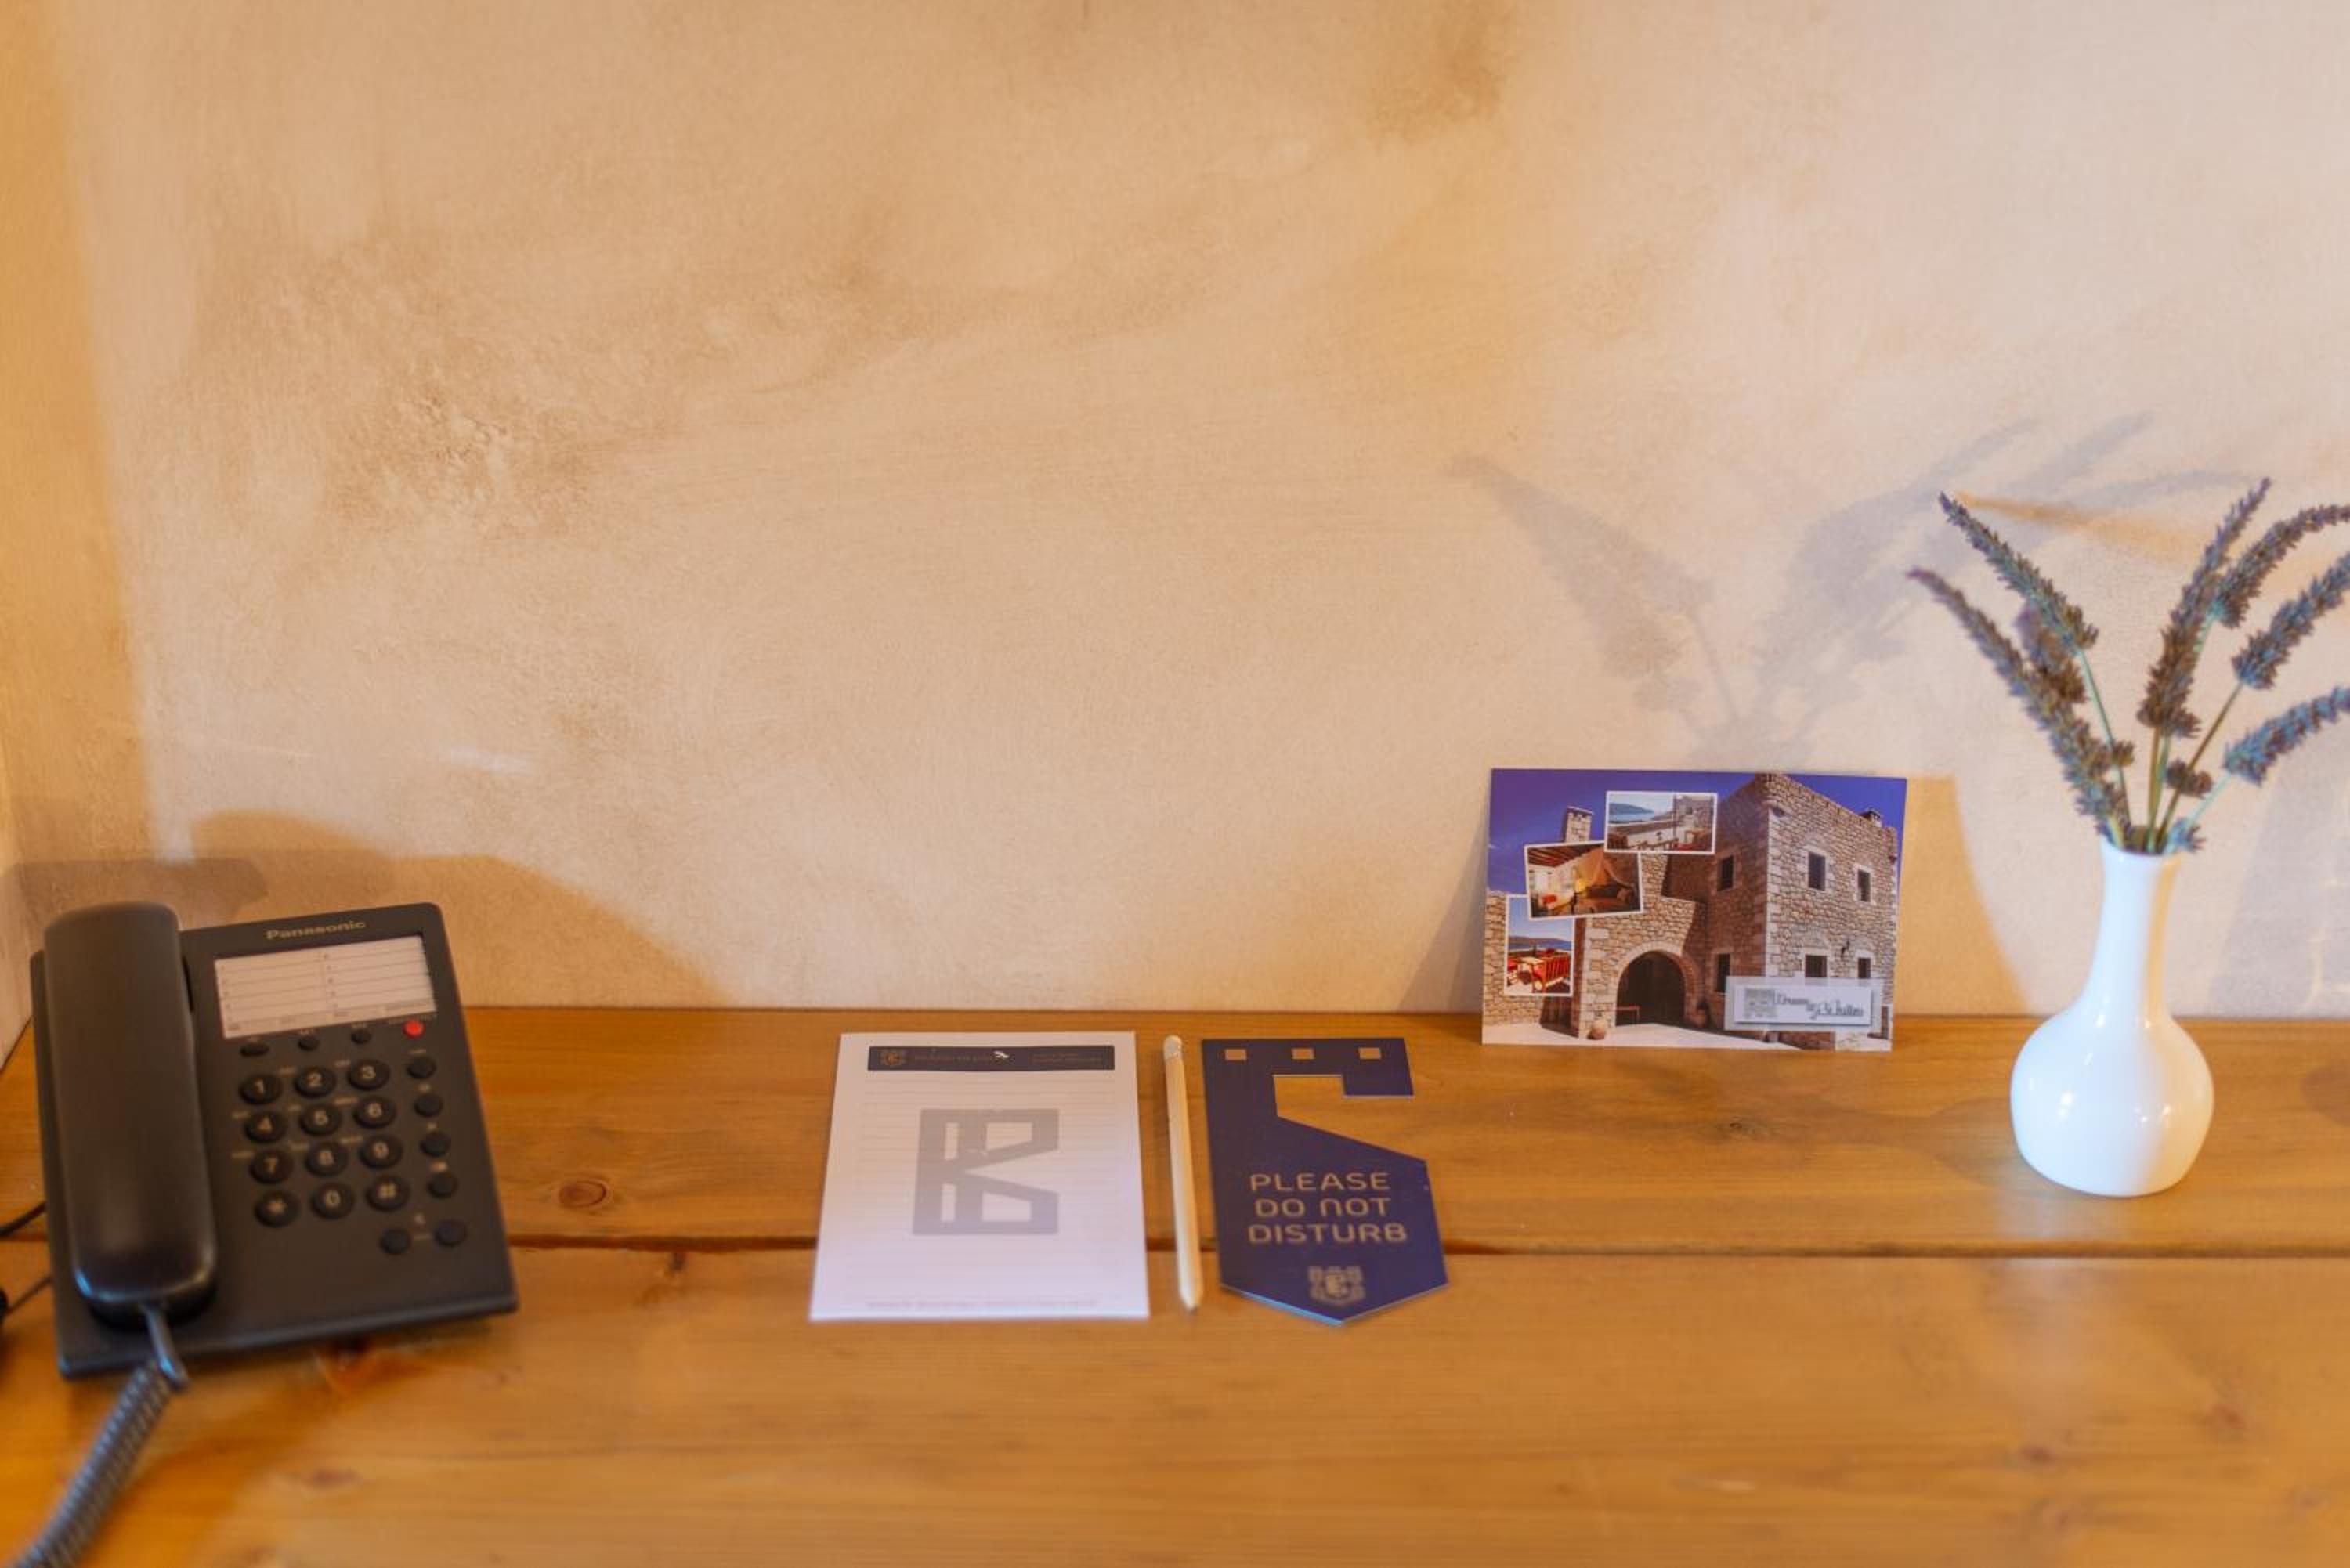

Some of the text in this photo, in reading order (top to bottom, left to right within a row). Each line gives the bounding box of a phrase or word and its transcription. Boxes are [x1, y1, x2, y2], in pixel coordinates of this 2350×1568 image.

[266, 920, 367, 940] Panasonic
[308, 1072, 323, 1087] 2
[361, 1065, 376, 1080] 3
[255, 1079, 265, 1094] 1
[367, 1103, 382, 1118] 6
[258, 1117, 273, 1132] 4
[374, 1142, 389, 1158] 9
[265, 1157, 277, 1172] 7
[1250, 1172, 1391, 1191] PLEASE
[325, 1190, 342, 1207] 0
[1254, 1198, 1306, 1216] DO
[1248, 1222, 1408, 1244] DISTURB
